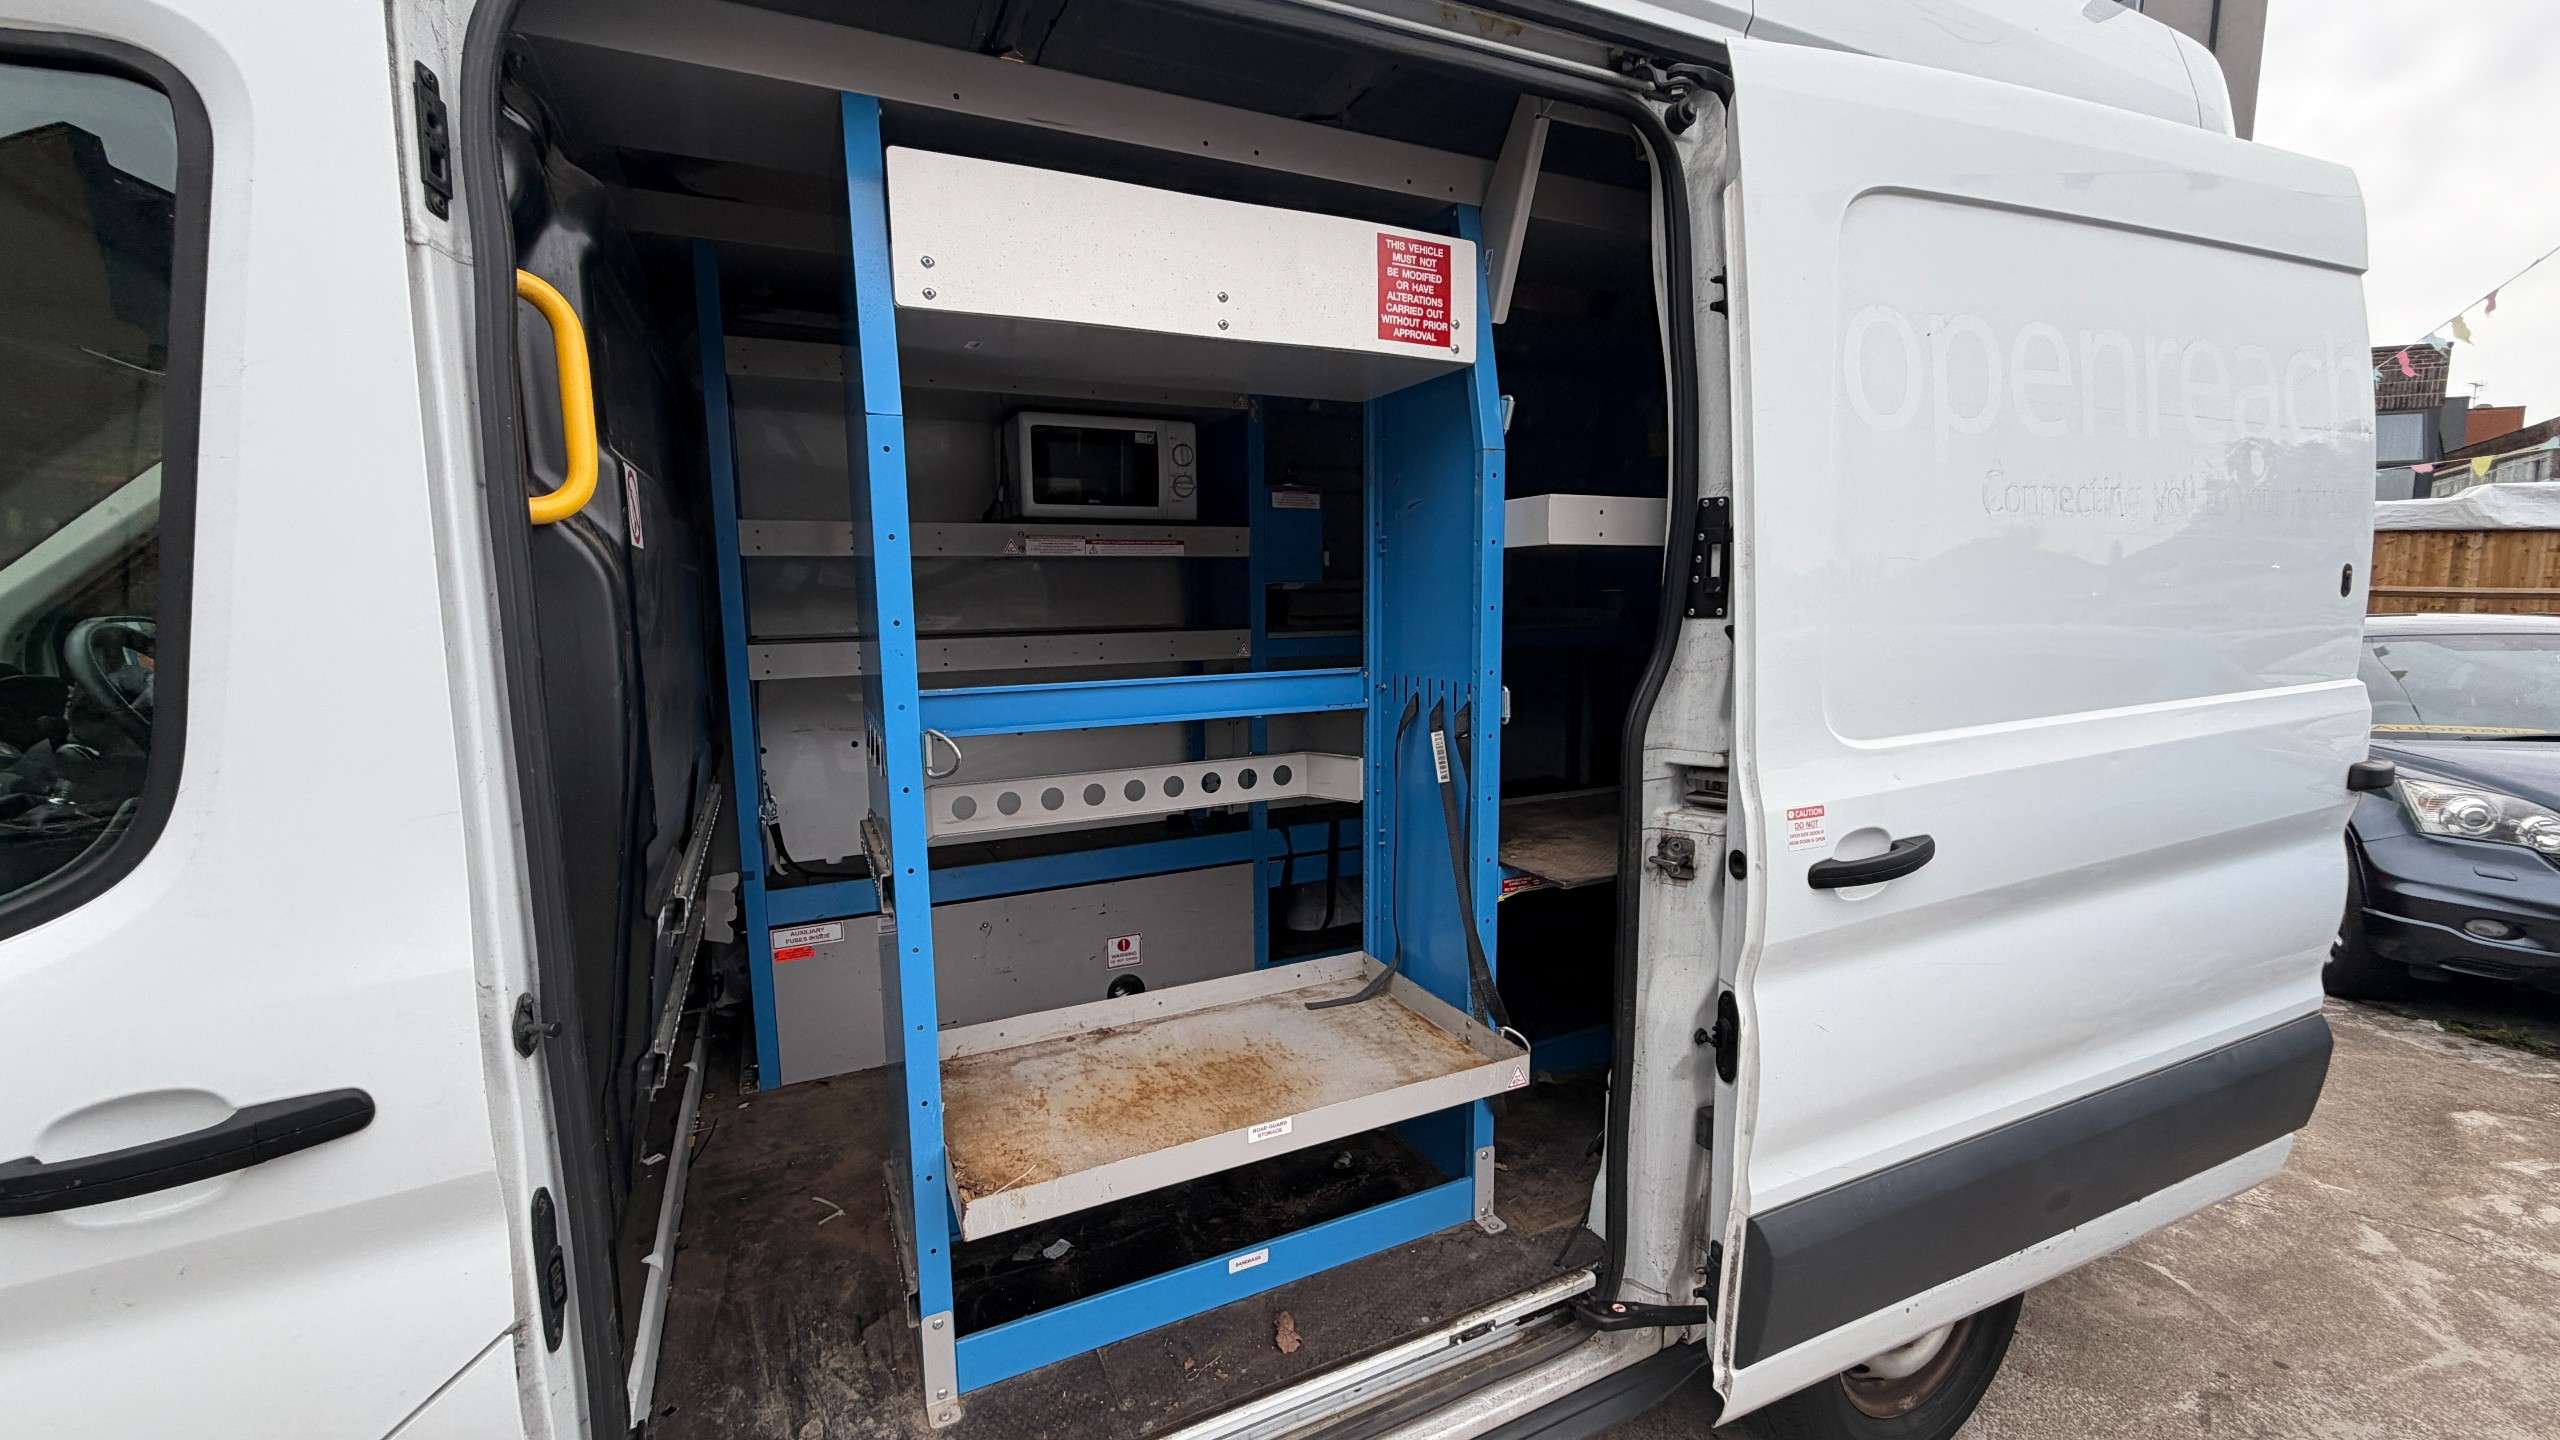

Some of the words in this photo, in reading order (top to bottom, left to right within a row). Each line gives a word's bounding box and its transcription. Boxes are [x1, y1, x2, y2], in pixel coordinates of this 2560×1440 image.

[1386, 239, 1405, 251] THIS
[1408, 243, 1444, 257] VEHICLE
[1392, 253, 1416, 265] MUST
[1420, 257, 1437, 268] NOT
[1387, 267, 1399, 277] BE
[1402, 269, 1442, 284] MODIFIED
[1396, 280, 1409, 290] OR
[1412, 282, 1434, 294] HAVE
[1387, 291, 1443, 307] ALTERATIONS
[1386, 303, 1423, 316] CARRIED
[1426, 309, 1444, 319] OUT
[1381, 314, 1420, 328] WITHOUT
[1423, 320, 1448, 332] PRIOR
[1393, 328, 1437, 341] APPROVAL
[1843, 303, 2374, 465] openreach
[1795, 807, 1823, 817] CAUTION
[1795, 821, 1804, 829] DO
[1806, 820, 1818, 828] NOT
[790, 927, 825, 937] AUXILIARY
[785, 936, 807, 944] FUSES
[1252, 1126, 1268, 1134] ROAD
[1269, 1120, 1288, 1129] GUARD
